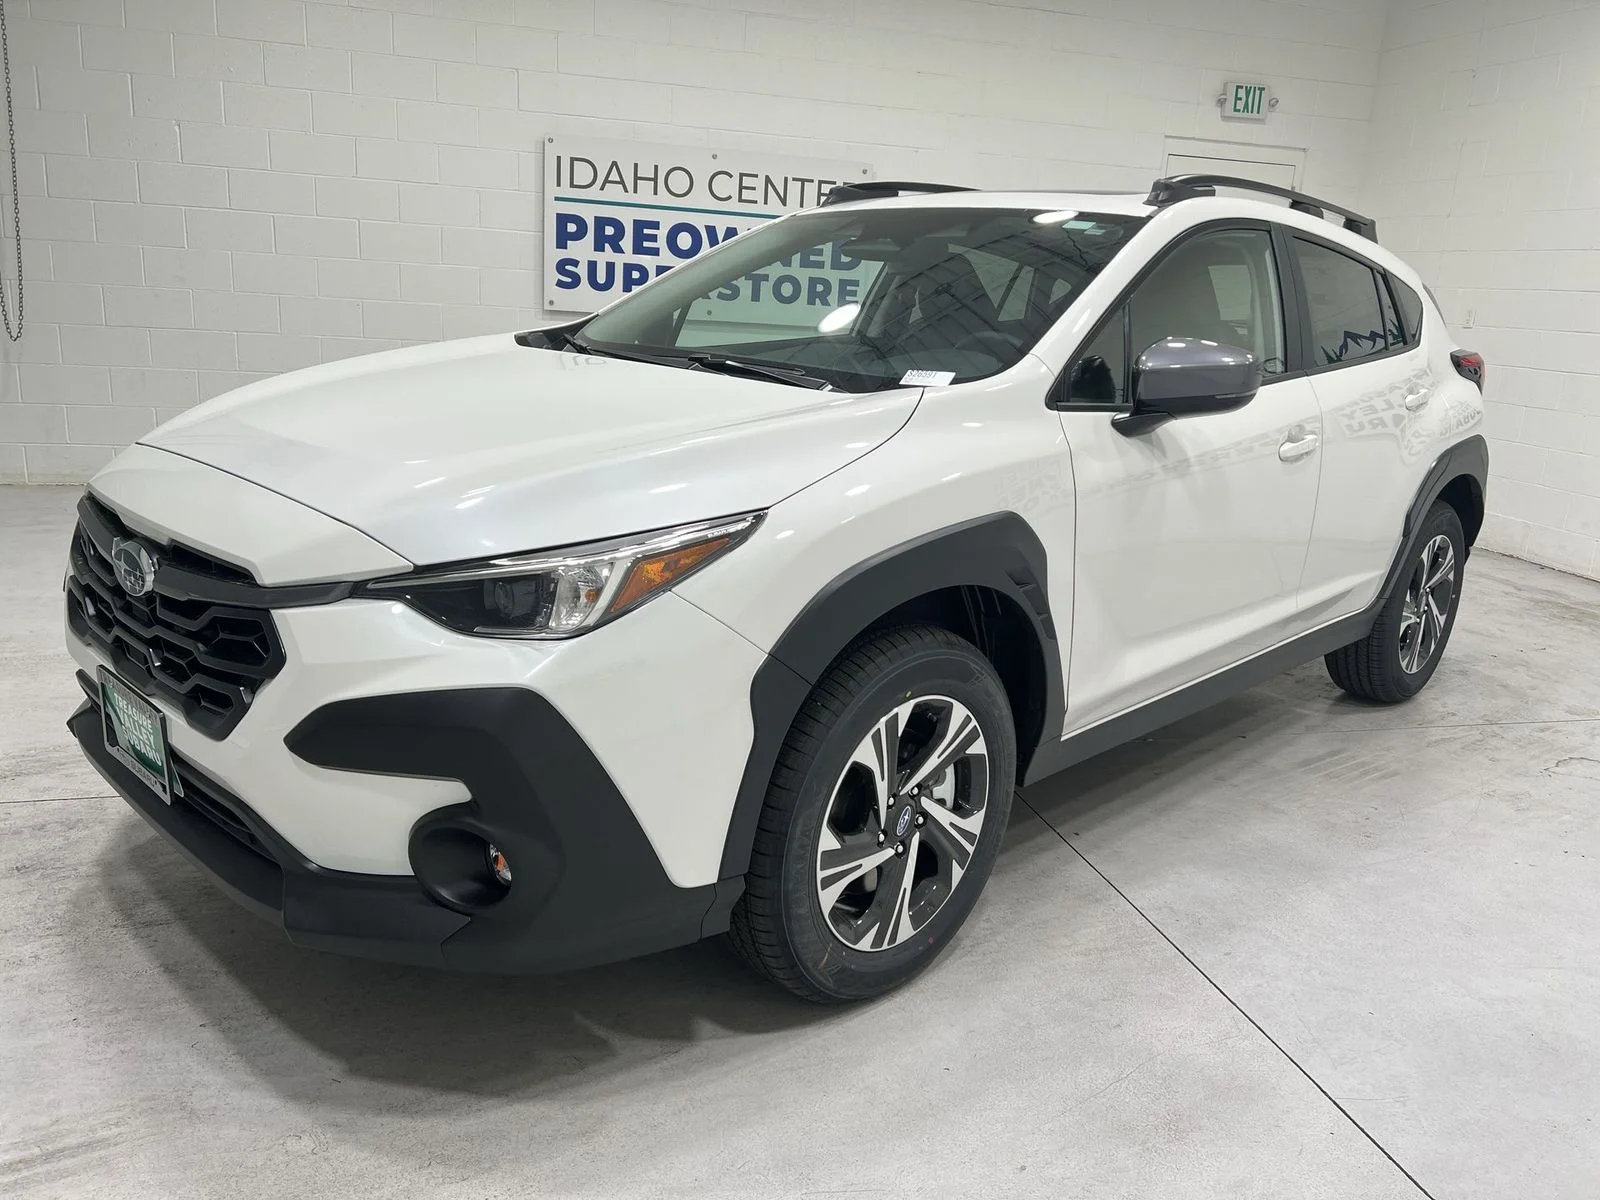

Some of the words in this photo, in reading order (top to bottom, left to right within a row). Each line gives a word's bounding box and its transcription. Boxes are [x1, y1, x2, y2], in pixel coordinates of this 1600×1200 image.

[1232, 85, 1266, 114] EXIT
[556, 155, 694, 198] IDAHO
[707, 170, 856, 209] CENTE
[113, 692, 153, 734] TREASURE
[115, 706, 155, 749] VALLEY
[121, 724, 162, 768] SUBARU
